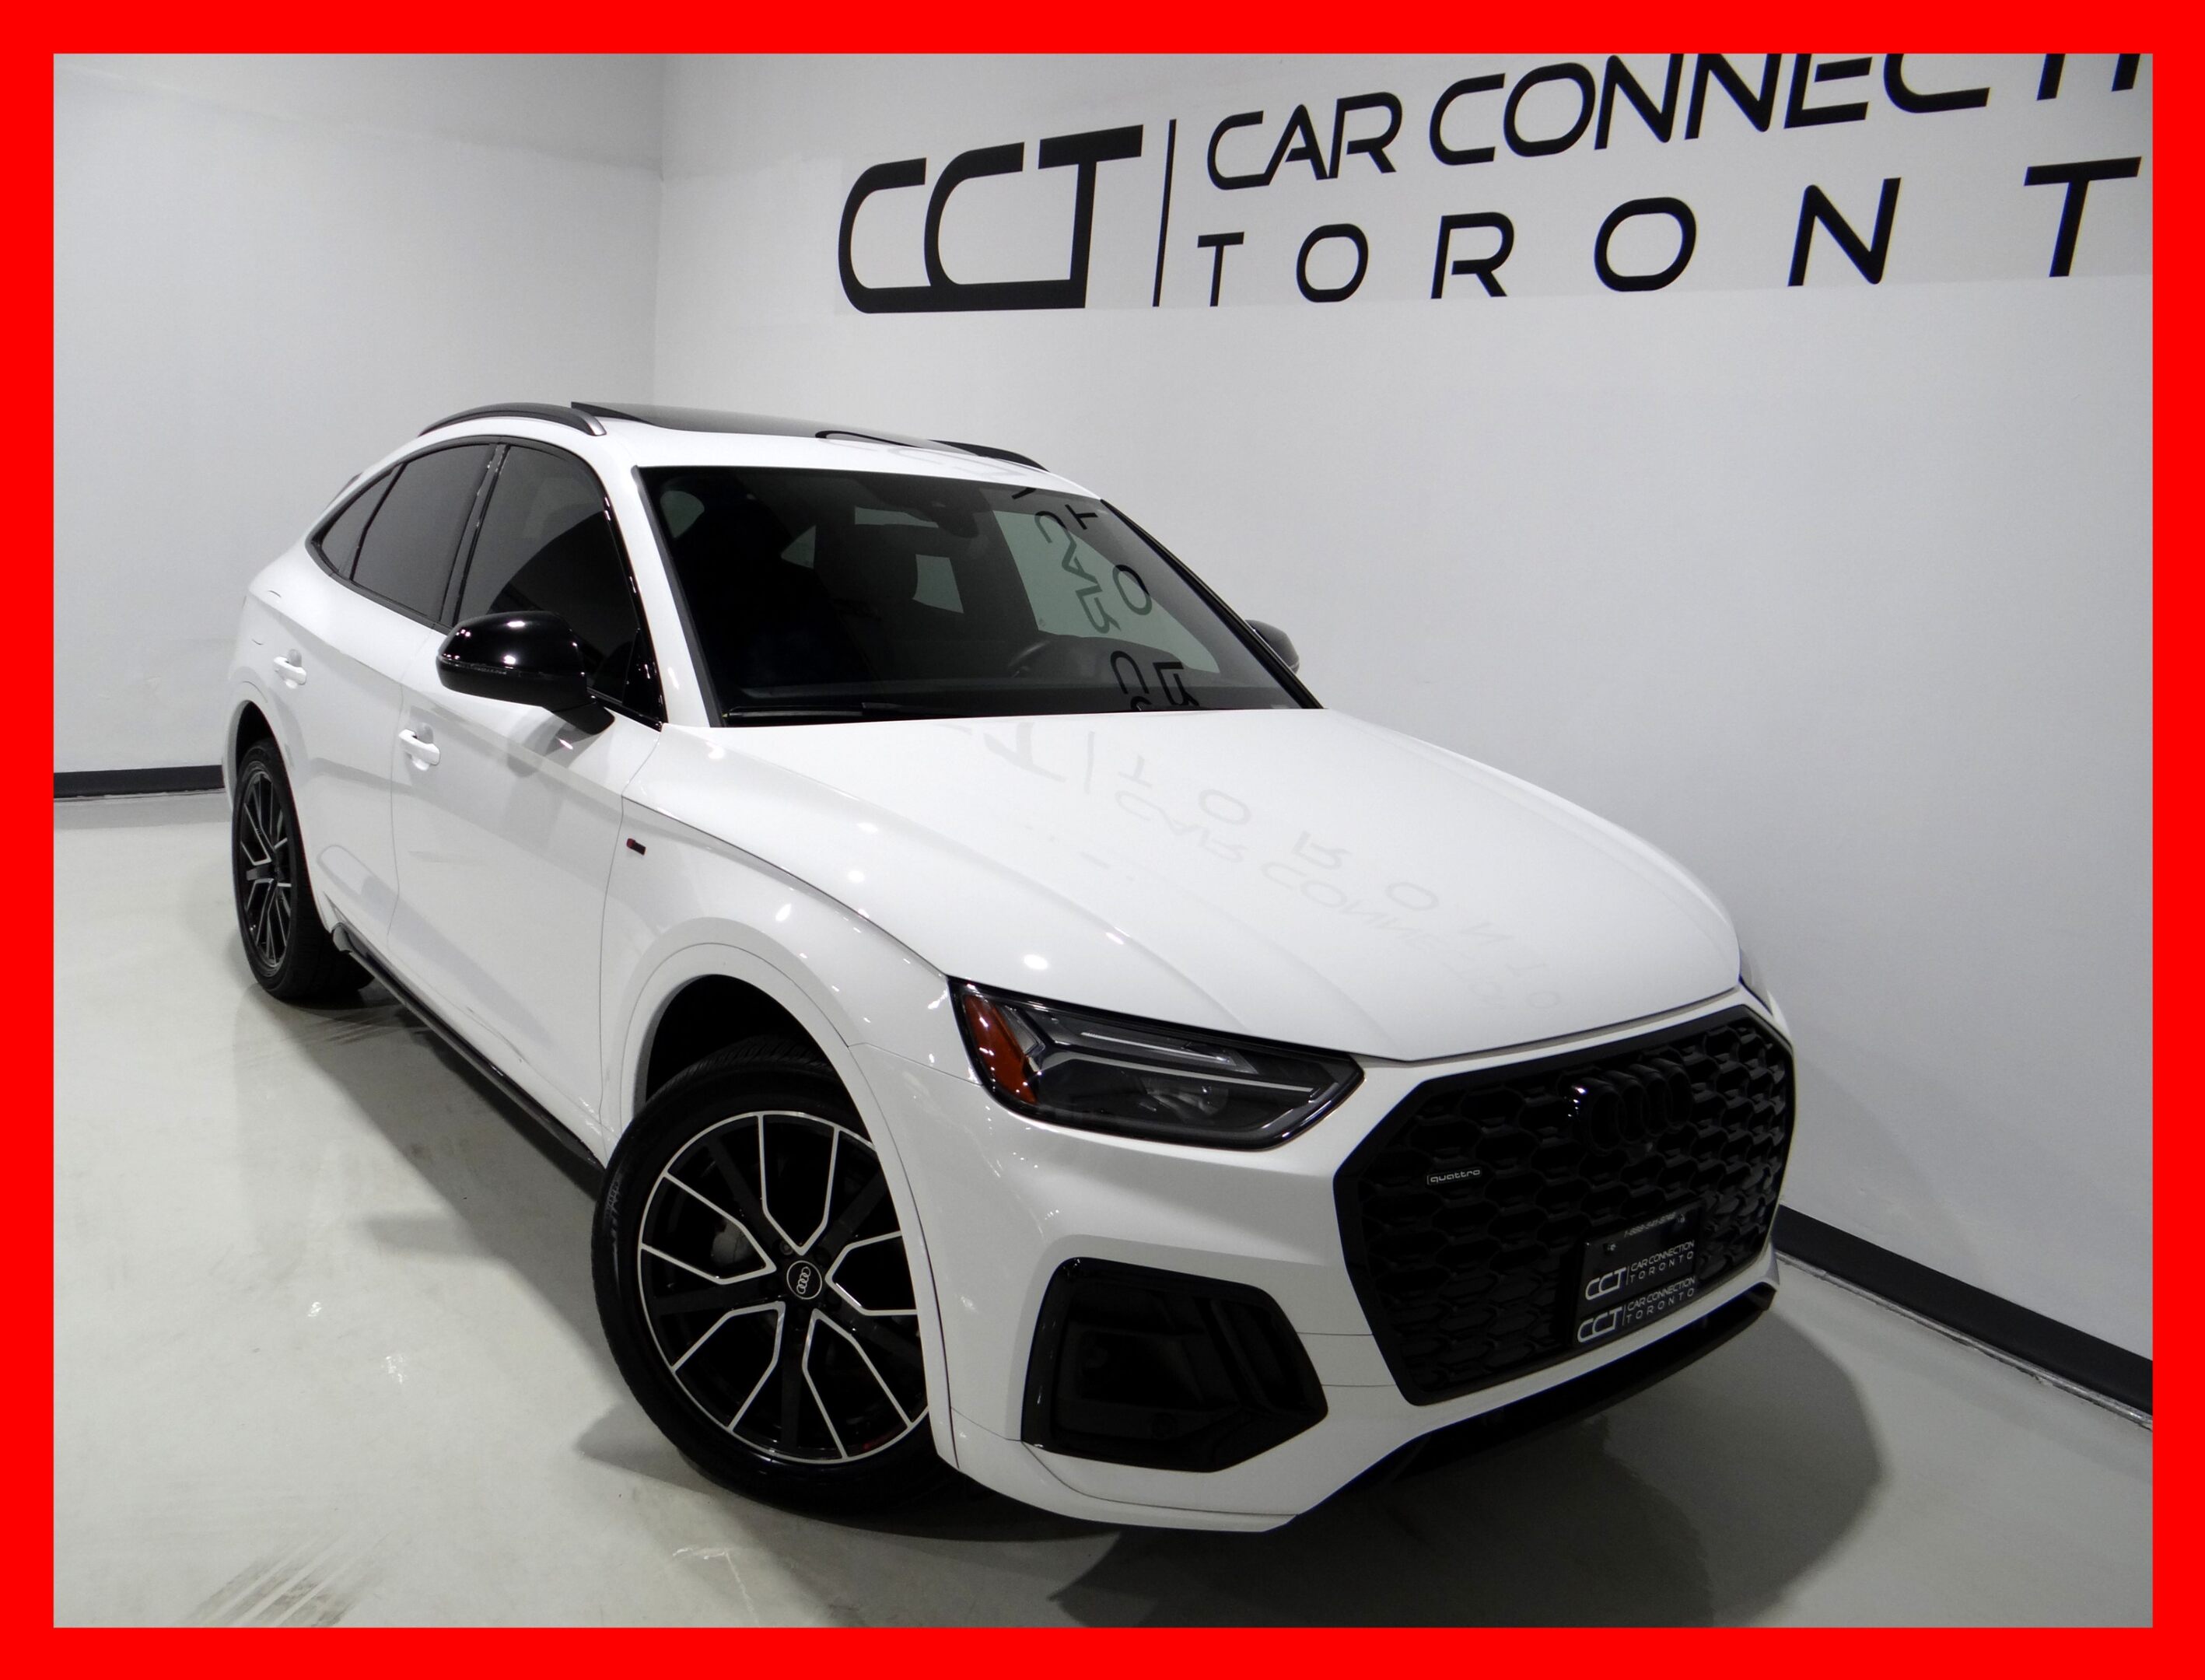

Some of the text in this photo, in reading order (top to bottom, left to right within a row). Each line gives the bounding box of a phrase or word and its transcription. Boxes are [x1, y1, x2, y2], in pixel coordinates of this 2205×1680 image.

[1207, 92, 1402, 191] CAR
[838, 124, 1143, 314] CCT
[1430, 1169, 1481, 1183] quattro
[1629, 1251, 1694, 1283] TORONTO
[1630, 1240, 1695, 1272] CAR CONNECTION
[1584, 1266, 1627, 1300] CCT
[1627, 1276, 1696, 1311] CAR CONNECTION
[1626, 1288, 1694, 1324] TORONTO
[1577, 1307, 1623, 1343] CCT
